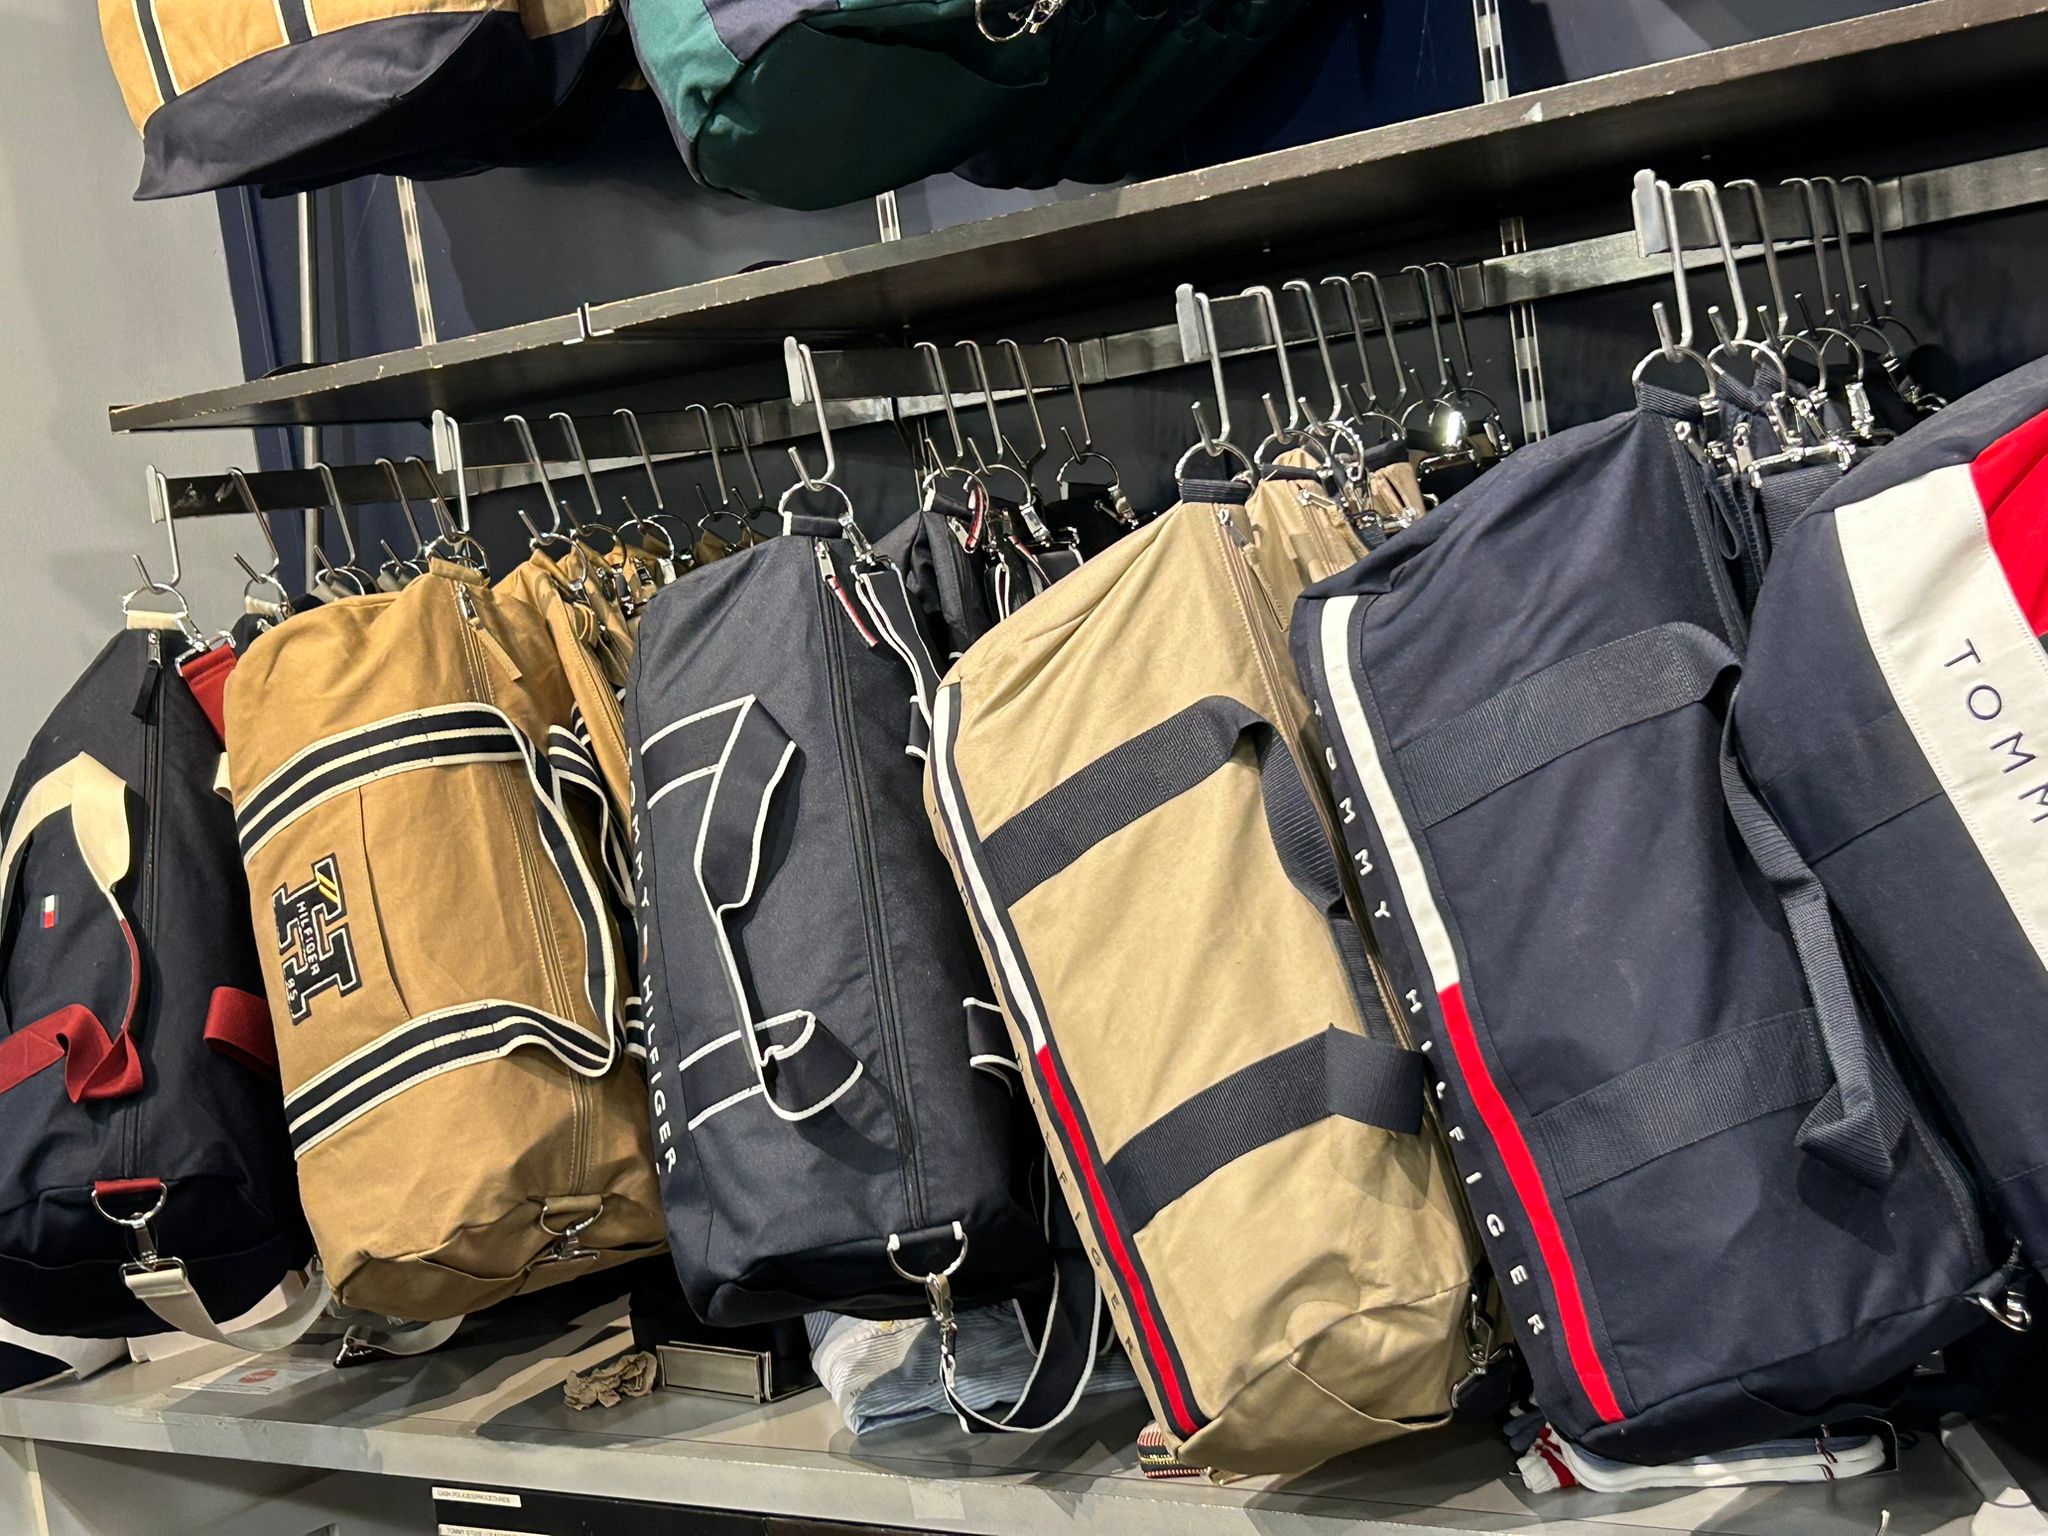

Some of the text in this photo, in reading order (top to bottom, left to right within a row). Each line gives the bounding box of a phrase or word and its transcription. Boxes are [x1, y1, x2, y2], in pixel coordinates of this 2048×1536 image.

[296, 901, 320, 976] HILFIGER
[1314, 699, 1545, 1335] TOMMY HILFIGER
[643, 974, 677, 1174] HILFIGER
